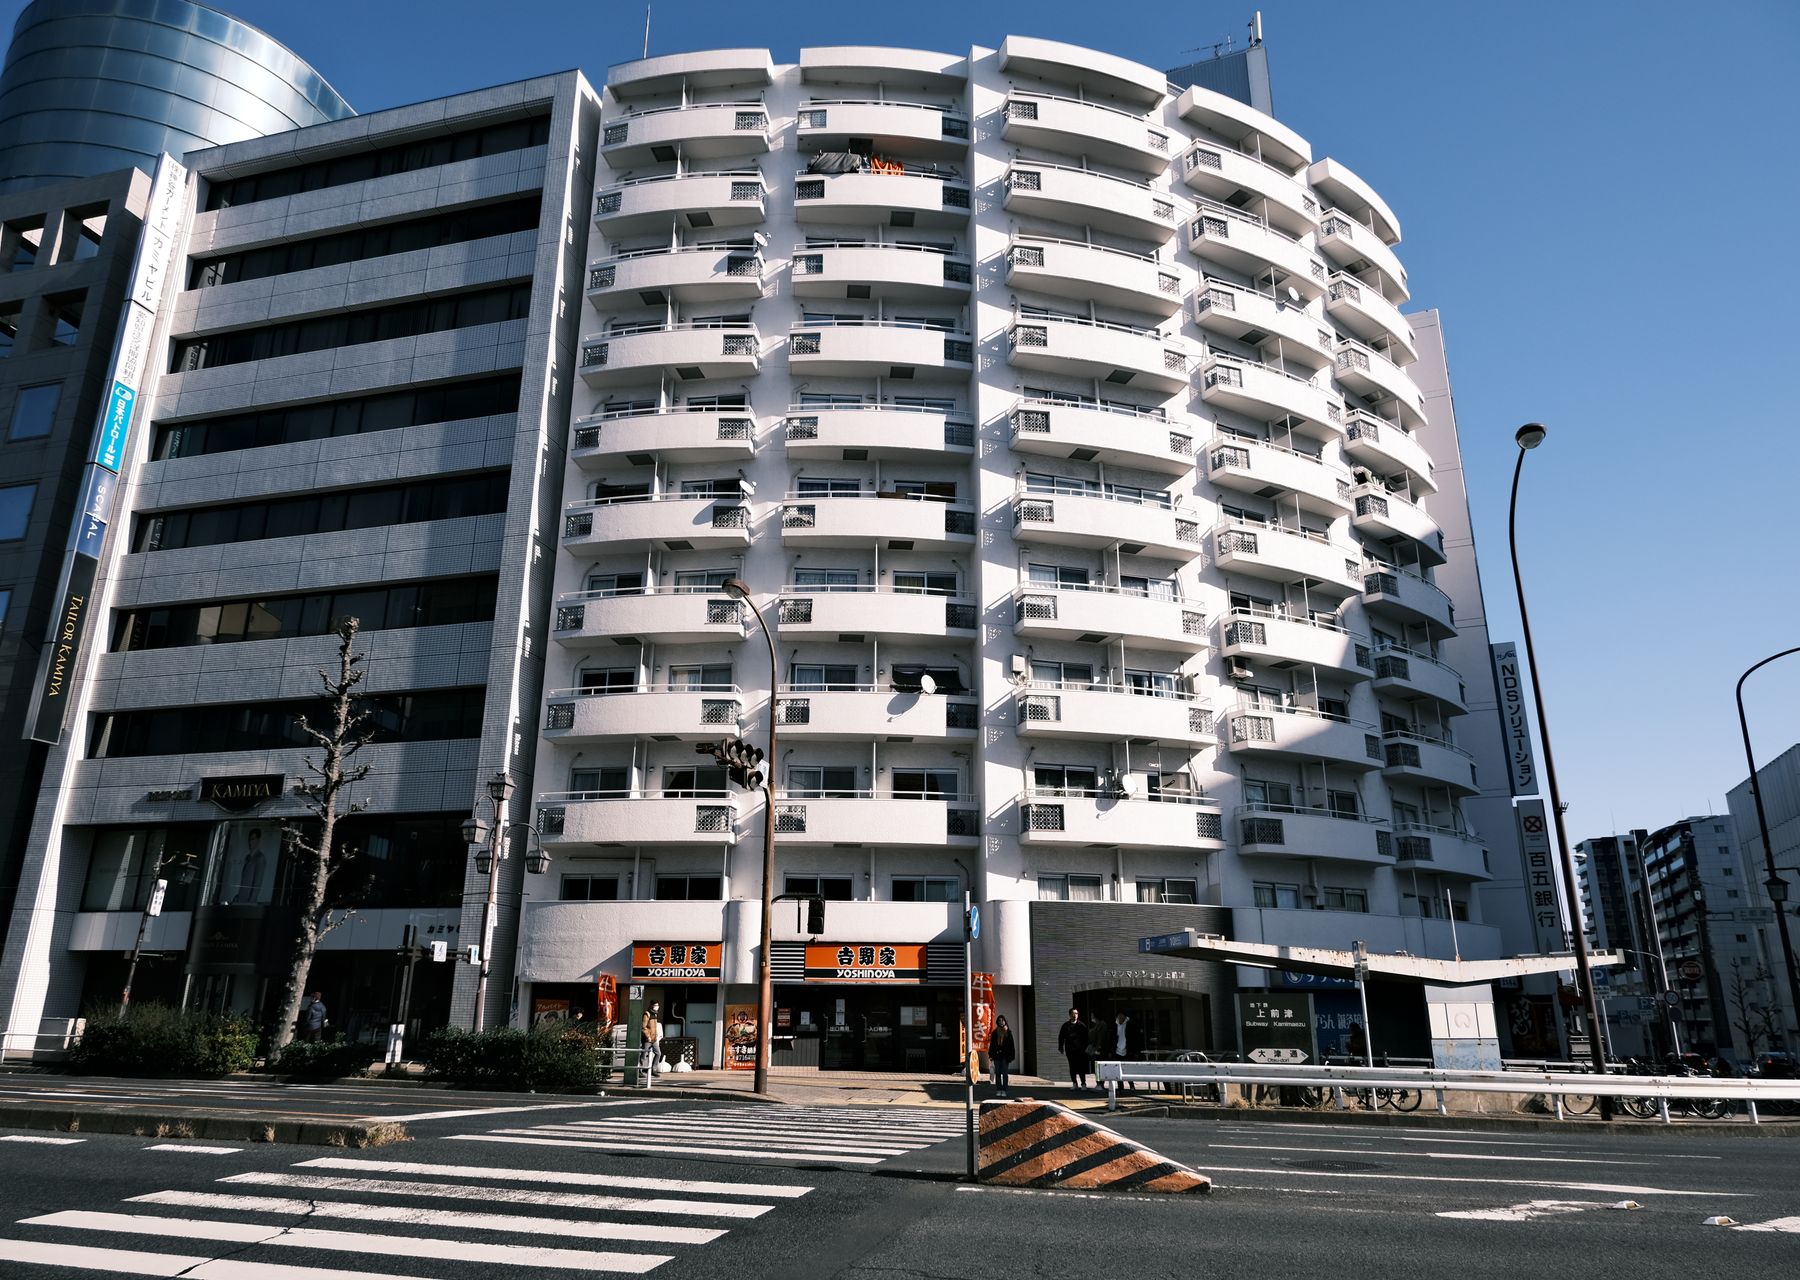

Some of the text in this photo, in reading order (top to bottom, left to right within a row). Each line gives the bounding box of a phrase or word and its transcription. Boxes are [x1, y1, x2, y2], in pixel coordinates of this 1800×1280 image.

[141, 236, 164, 302] カミヤビル
[86, 485, 107, 540] SCABAL
[48, 595, 84, 698] TAILOR KAMIYA
[1501, 663, 1532, 787] NDSソリューション
[211, 783, 271, 799] KAMIYA
[1528, 851, 1556, 928] 百五銀行
[648, 968, 706, 977] YOSHINOYA
[836, 969, 896, 978] YOSHINOYA
[972, 975, 992, 1042] 牛すき
[1245, 1020, 1306, 1028] Subway Kamimaezu
[1256, 1009, 1294, 1019] 上前津
[1258, 1050, 1298, 1058] 大津通
